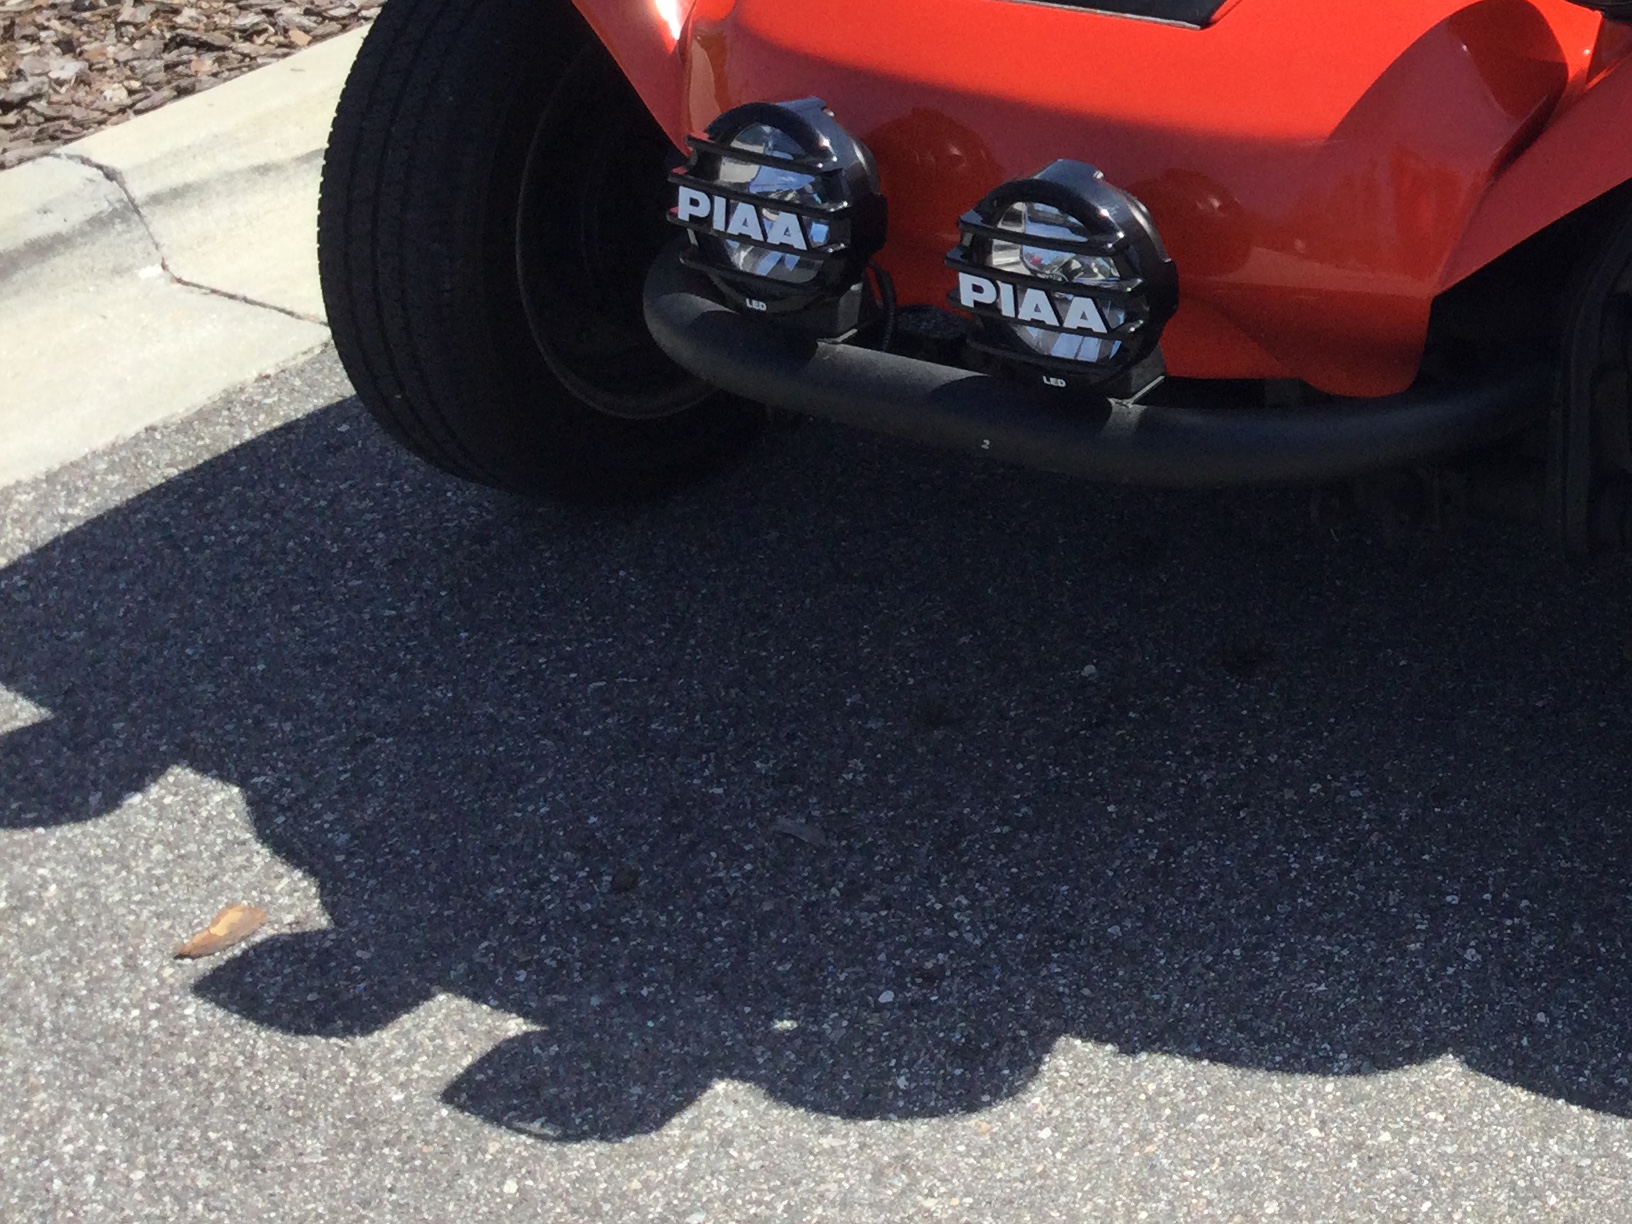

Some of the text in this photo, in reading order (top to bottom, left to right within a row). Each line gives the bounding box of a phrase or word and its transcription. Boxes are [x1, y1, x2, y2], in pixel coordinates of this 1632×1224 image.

[678, 185, 808, 251] PIAA
[746, 298, 767, 311] LED
[959, 272, 1107, 333] PIAA
[1043, 376, 1066, 387] LED
